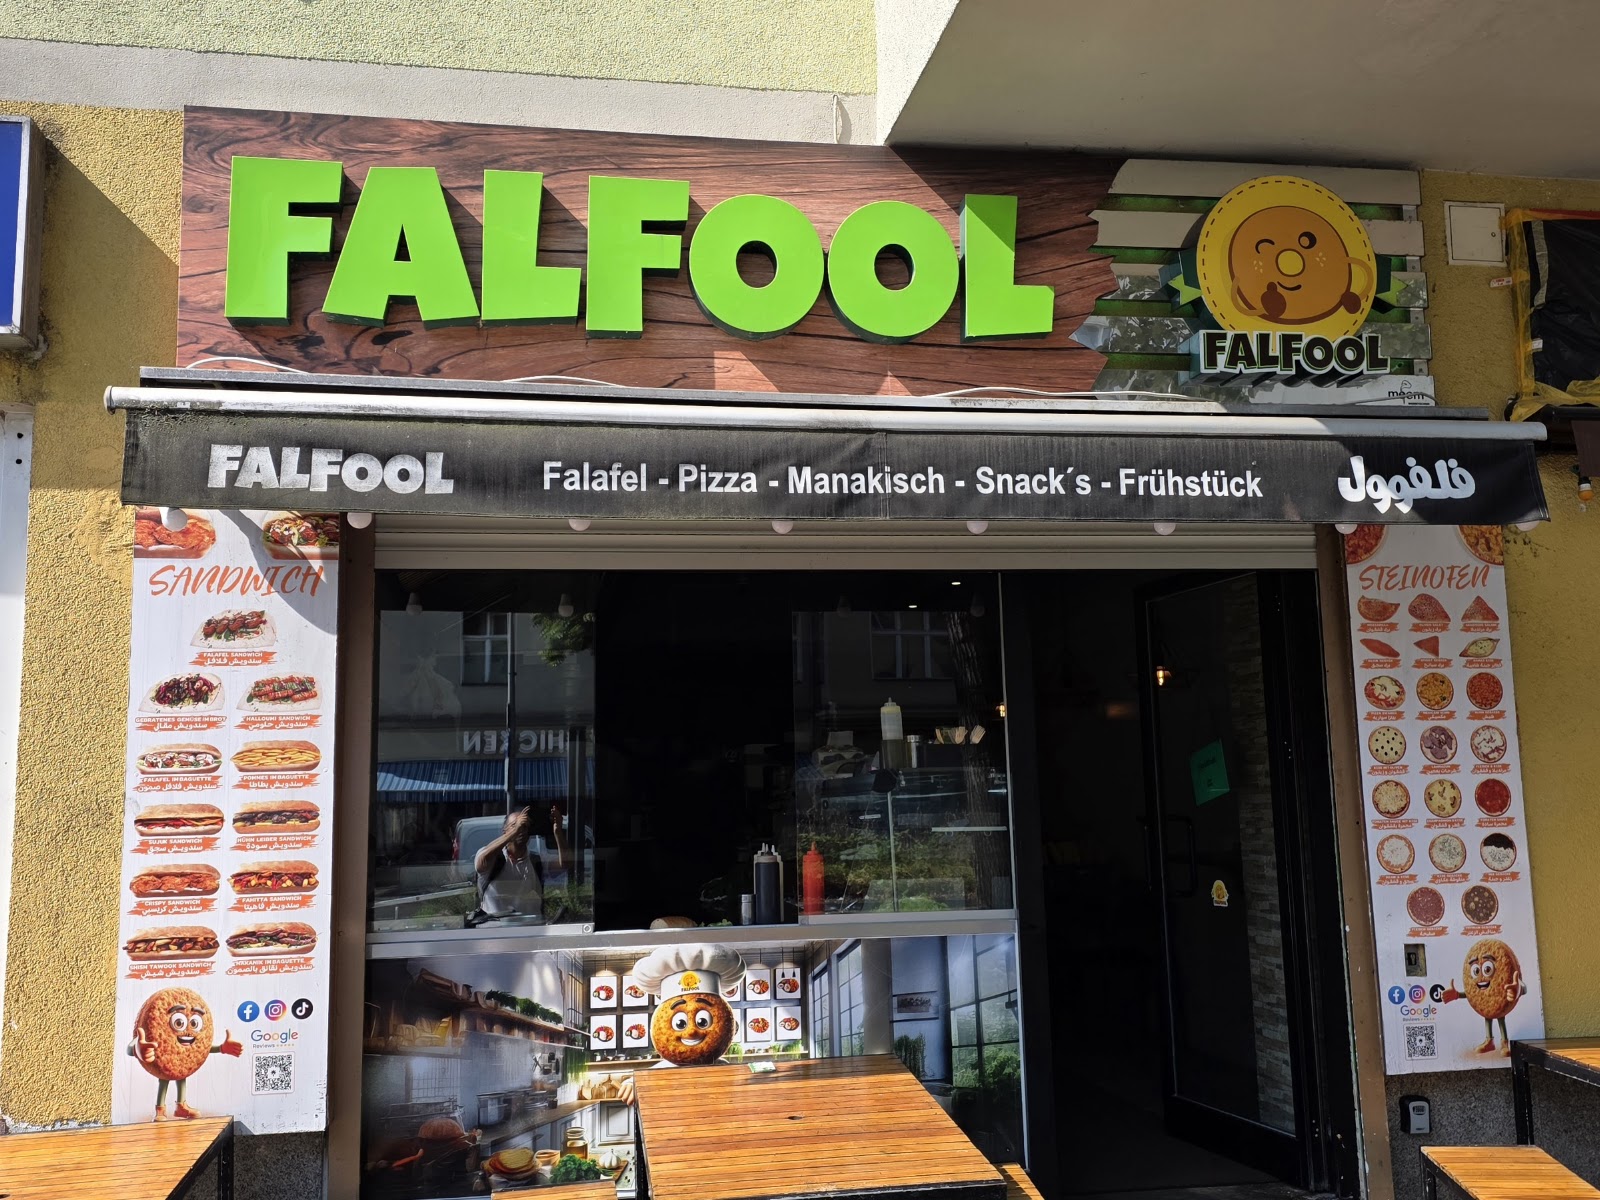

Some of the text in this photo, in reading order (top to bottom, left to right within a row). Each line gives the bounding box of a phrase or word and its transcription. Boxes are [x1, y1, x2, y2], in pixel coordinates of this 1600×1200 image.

[224, 156, 1055, 342] FALFOOL
[1202, 331, 1390, 373] FALFOOL
[208, 443, 454, 494] FALFOOL
[543, 461, 647, 491] Falafel
[679, 464, 757, 493] Pizza
[788, 466, 945, 494] Manakisch
[1119, 468, 1264, 498] Frühstück
[149, 564, 324, 597] SANDWICH
[1359, 564, 1490, 591] STEINOFEN
[204, 658, 227, 666] فلافل
[1400, 1004, 1437, 1018] Google
[251, 1028, 299, 1043] Google
